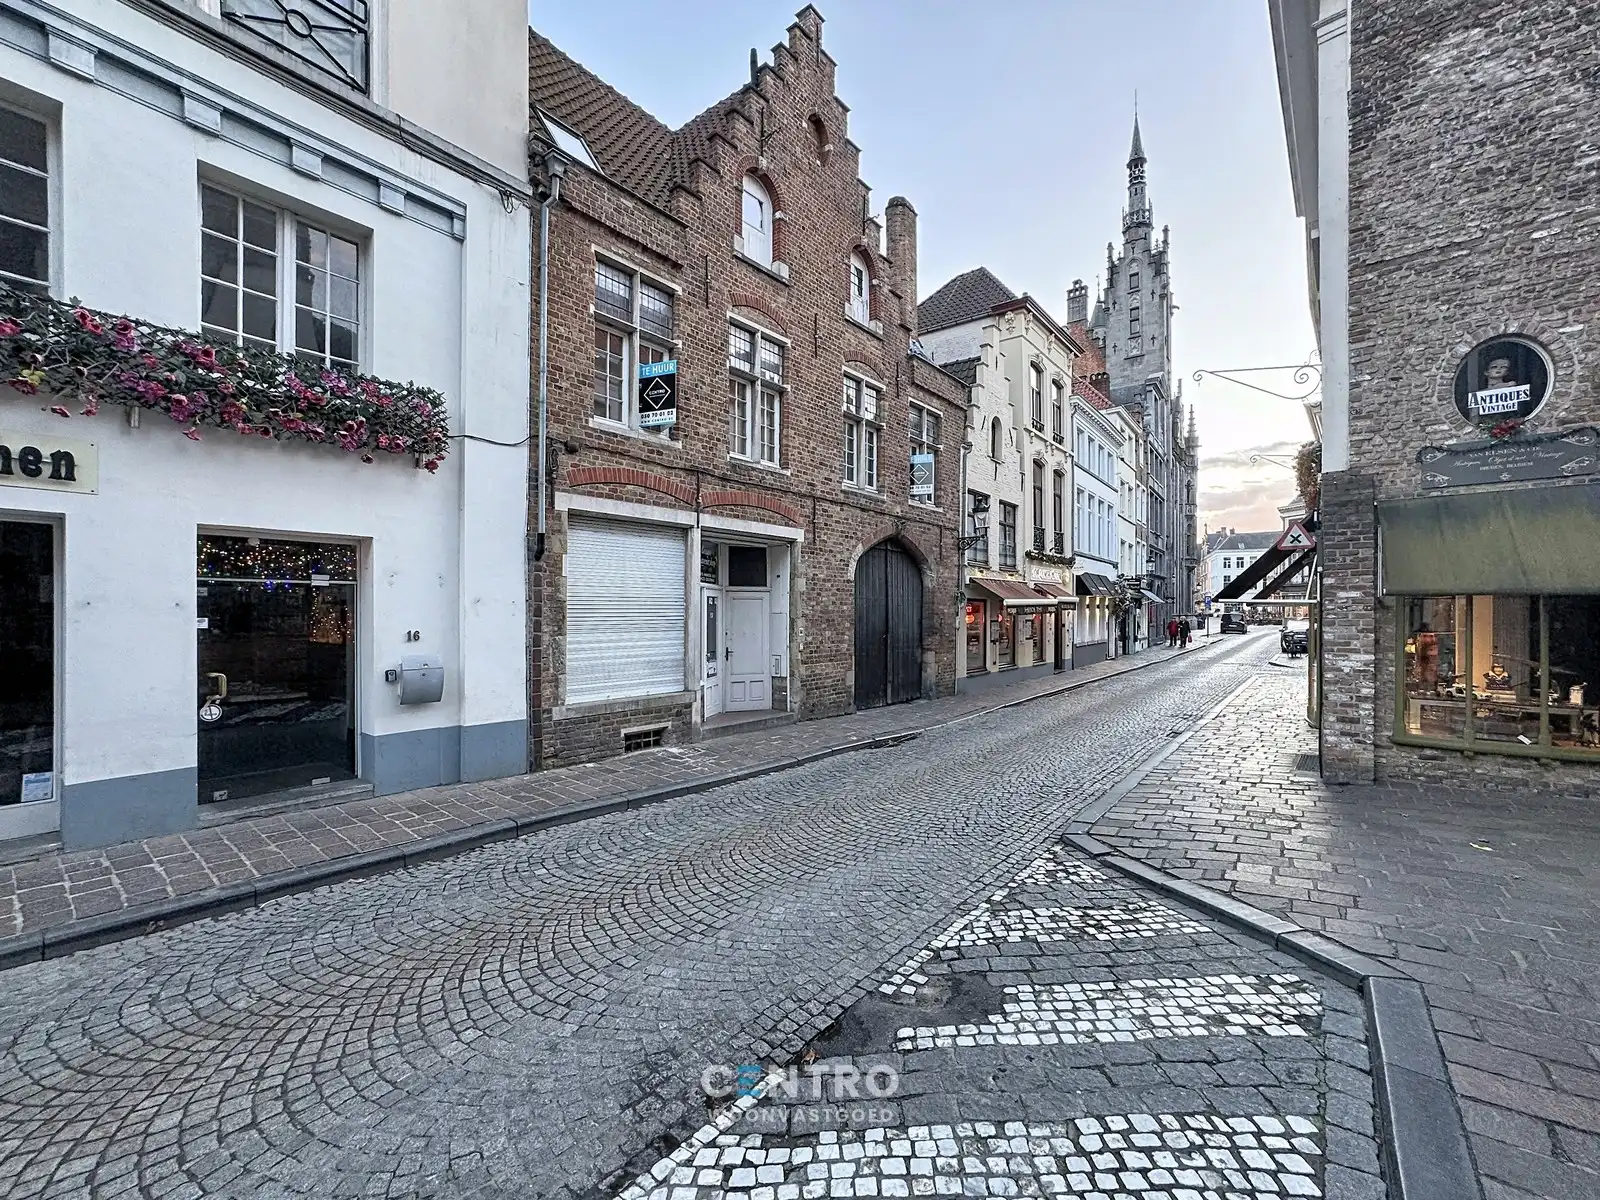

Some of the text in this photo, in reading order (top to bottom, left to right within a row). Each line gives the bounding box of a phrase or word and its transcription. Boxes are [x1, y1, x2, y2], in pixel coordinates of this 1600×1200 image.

[641, 363, 674, 376] TE HUUR
[1469, 388, 1529, 407] ANTIQUES
[1481, 402, 1517, 414] VINTAGE
[406, 630, 420, 643] 16
